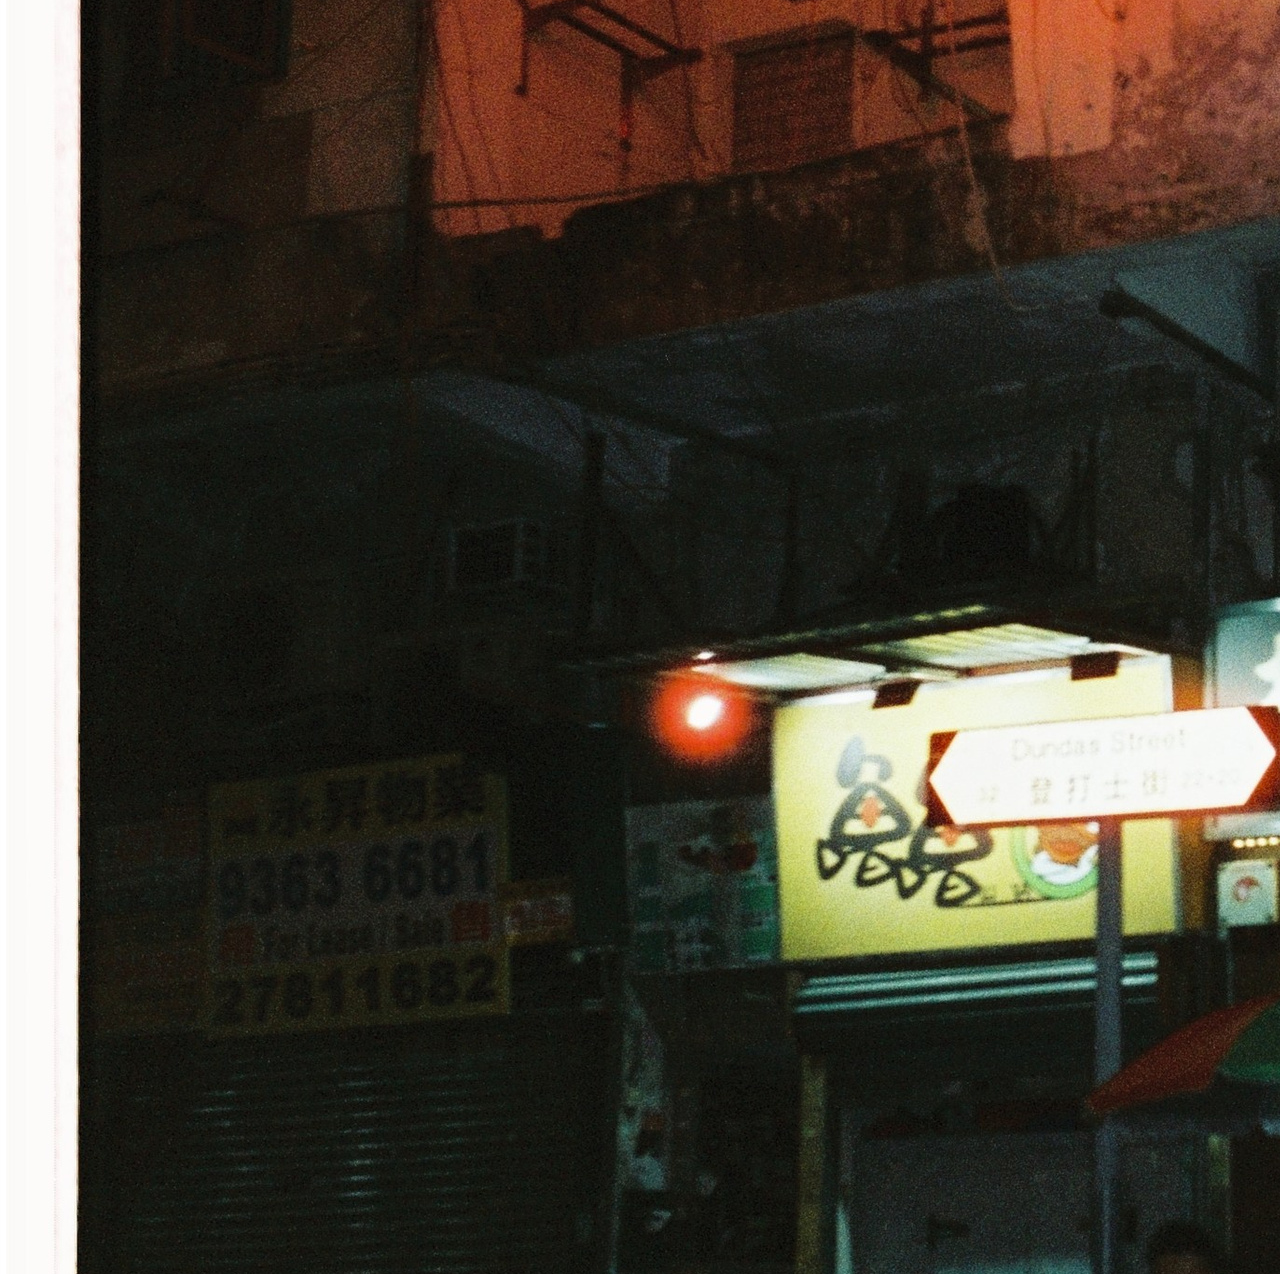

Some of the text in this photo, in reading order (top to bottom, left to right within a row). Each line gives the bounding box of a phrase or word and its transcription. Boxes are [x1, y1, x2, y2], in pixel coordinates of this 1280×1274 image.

[1011, 728, 1186, 761] Dundas Street
[1030, 770, 1168, 806] 登打士街
[218, 850, 342, 919] 9363
[363, 832, 490, 903] 6681
[213, 955, 498, 1027] 27811682
